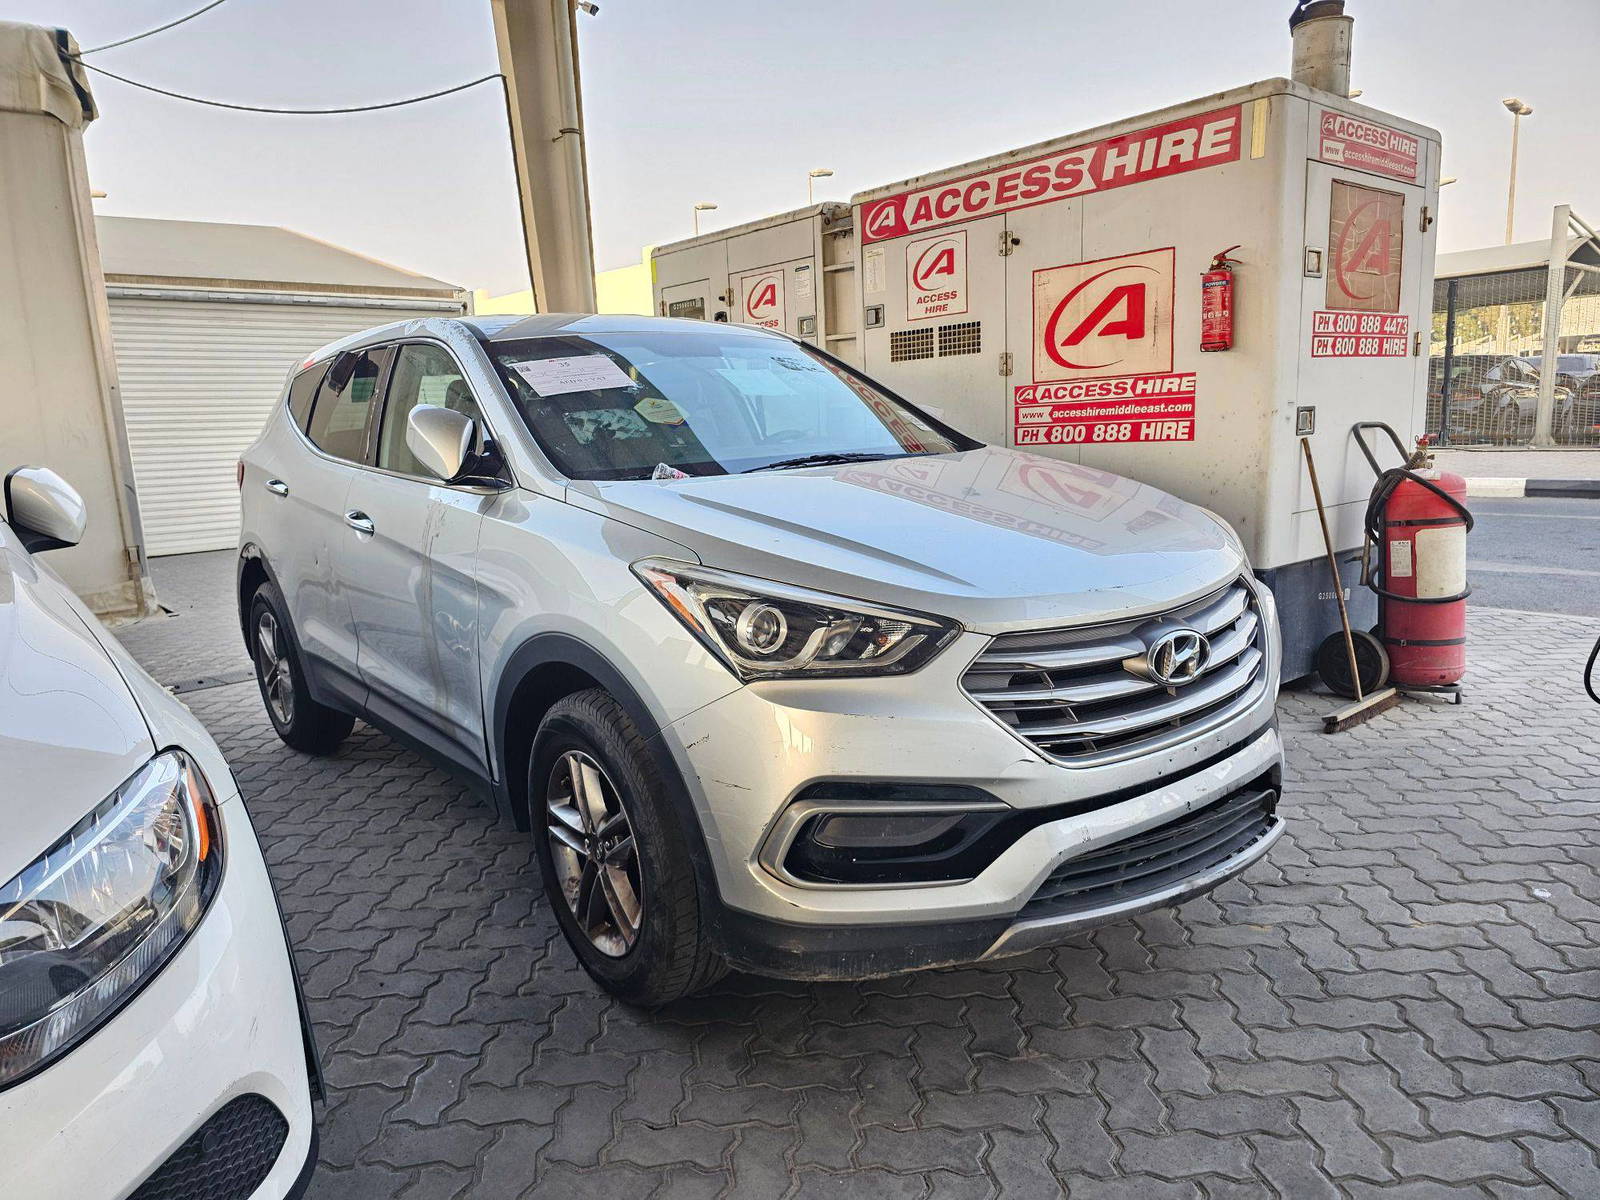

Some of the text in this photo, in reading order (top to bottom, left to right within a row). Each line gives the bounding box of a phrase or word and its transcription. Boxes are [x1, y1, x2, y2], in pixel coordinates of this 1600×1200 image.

[1337, 119, 1388, 147] ACCESS
[1389, 134, 1417, 157] HIRE
[909, 155, 1086, 226] ACCESS
[1101, 116, 1237, 182] HIRE
[916, 290, 957, 305] ACCESS
[924, 303, 949, 315] HIRE
[1317, 315, 1408, 335] PH 800 888 4473
[1316, 338, 1407, 356] PH 800 888 HIRE
[1039, 380, 1129, 401] ACCESS
[1135, 376, 1196, 396] HIRE
[1021, 402, 1193, 420] www accesshiremiddleeast.com
[1022, 421, 1191, 442] PH 800 888 HIRE
